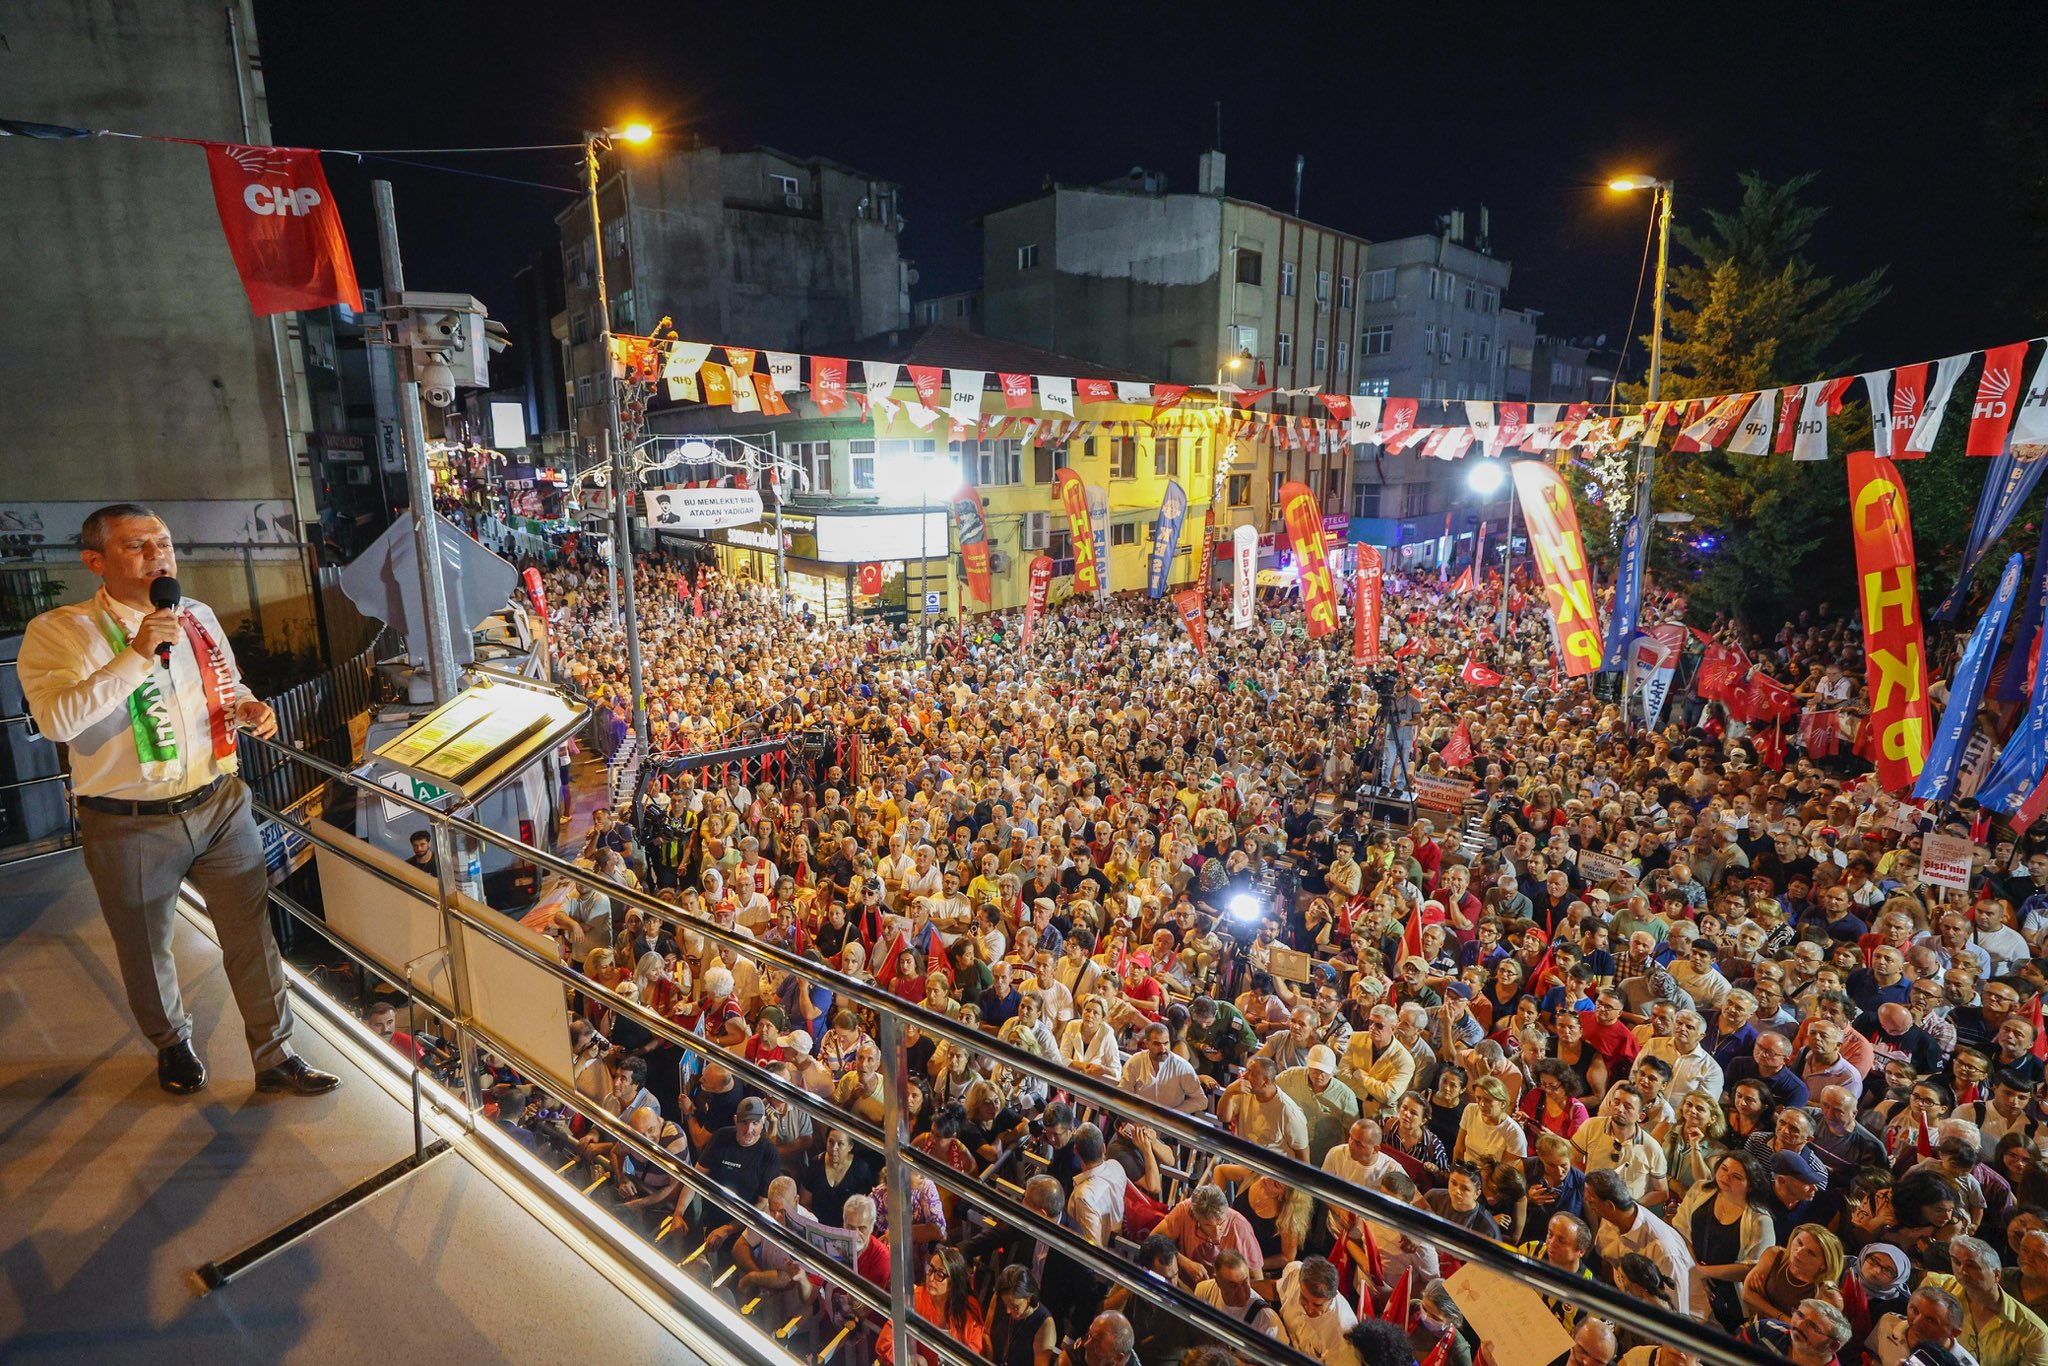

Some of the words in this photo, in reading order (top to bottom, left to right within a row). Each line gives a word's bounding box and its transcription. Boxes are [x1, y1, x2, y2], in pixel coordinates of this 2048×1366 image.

[243, 183, 321, 217] CHP
[769, 364, 792, 375] CHP
[820, 380, 840, 390] CHP
[919, 388, 934, 398] CHP
[1007, 387, 1027, 397] CHP
[1090, 388, 1110, 397] CHP
[954, 392, 975, 403] CHP
[1048, 393, 1067, 404] CHP
[1328, 401, 1347, 409] CHP
[1355, 420, 1371, 430] HP
[1394, 422, 1409, 432] CHP
[698, 497, 739, 505] MEMLEKET
[690, 509, 722, 517] ATA'DAN
[1032, 569, 1051, 577] CHP
[1924, 860, 1967, 875] Şişli'nin
